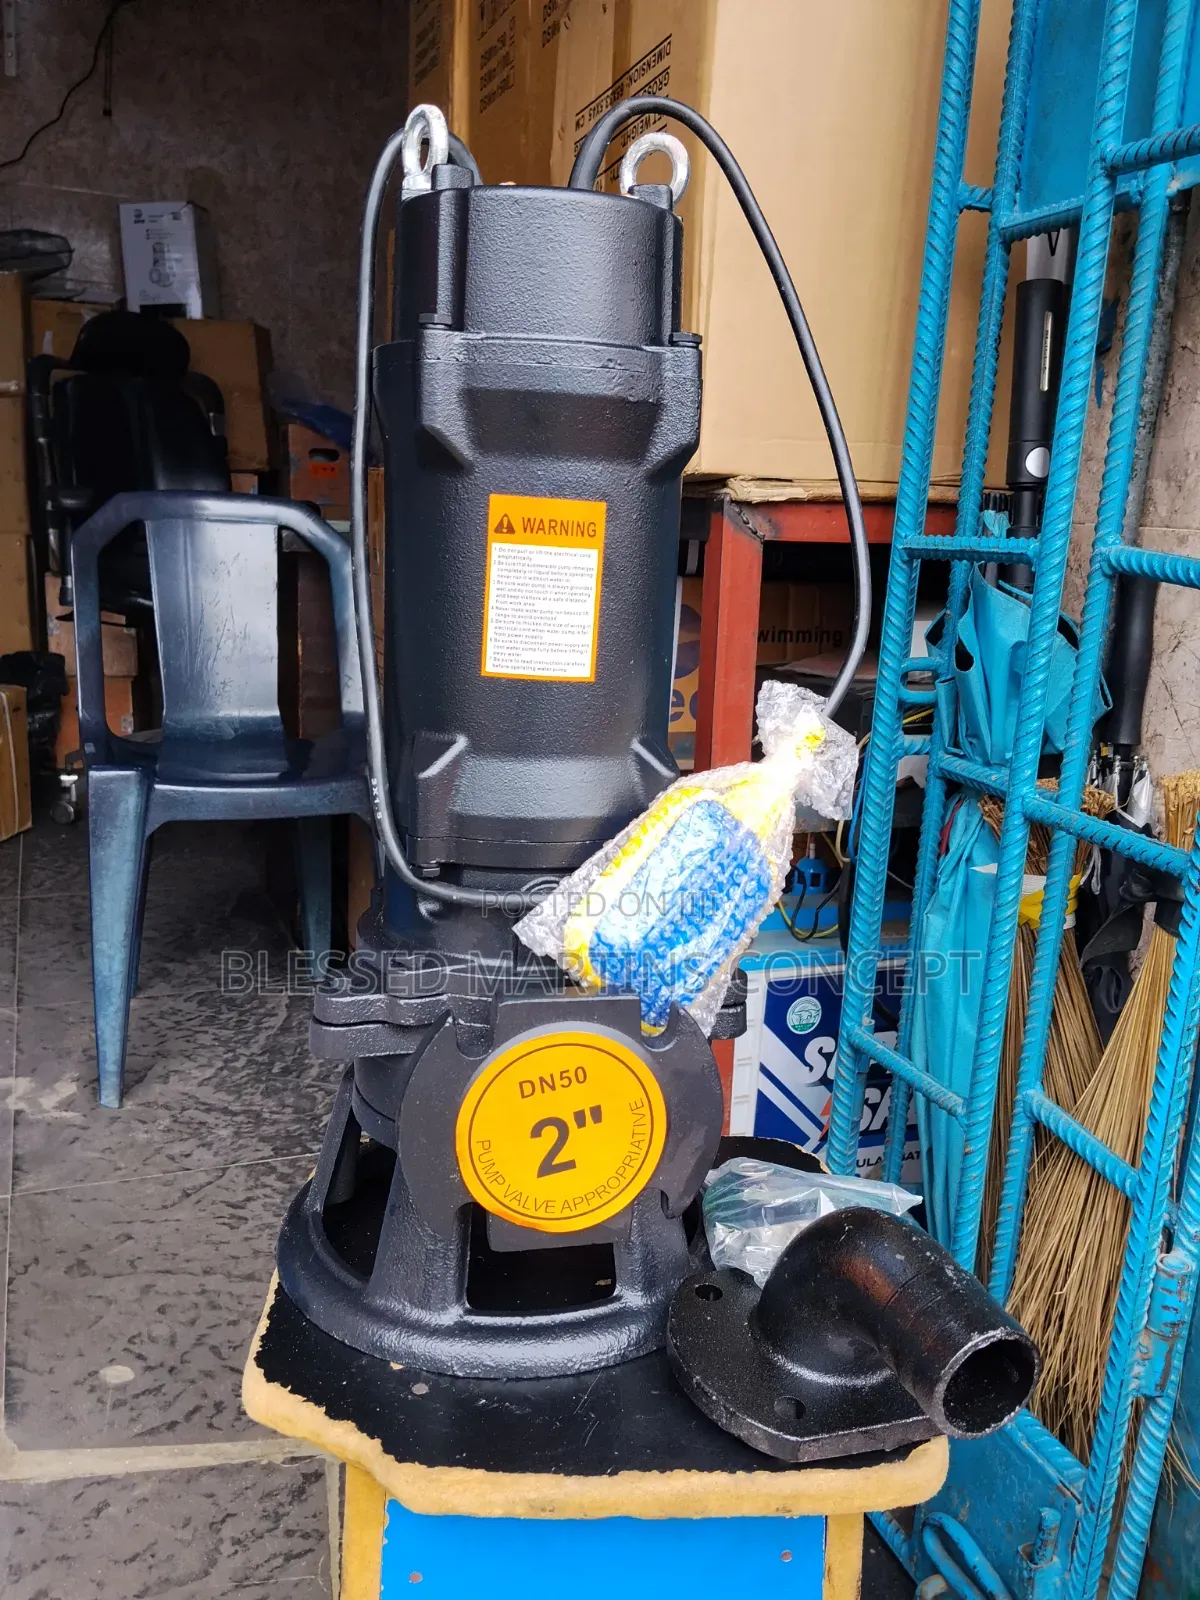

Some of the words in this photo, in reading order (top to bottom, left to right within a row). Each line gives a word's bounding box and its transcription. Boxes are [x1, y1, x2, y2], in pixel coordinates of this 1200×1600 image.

[522, 516, 597, 538] WARNING
[757, 626, 843, 648] wimming
[518, 1066, 588, 1099] DN50
[476, 1139, 506, 1187] PUMP
[503, 1183, 556, 1214] VALVE
[560, 1098, 646, 1214] APPROPRIATIVE
[530, 1104, 603, 1179] 2"
